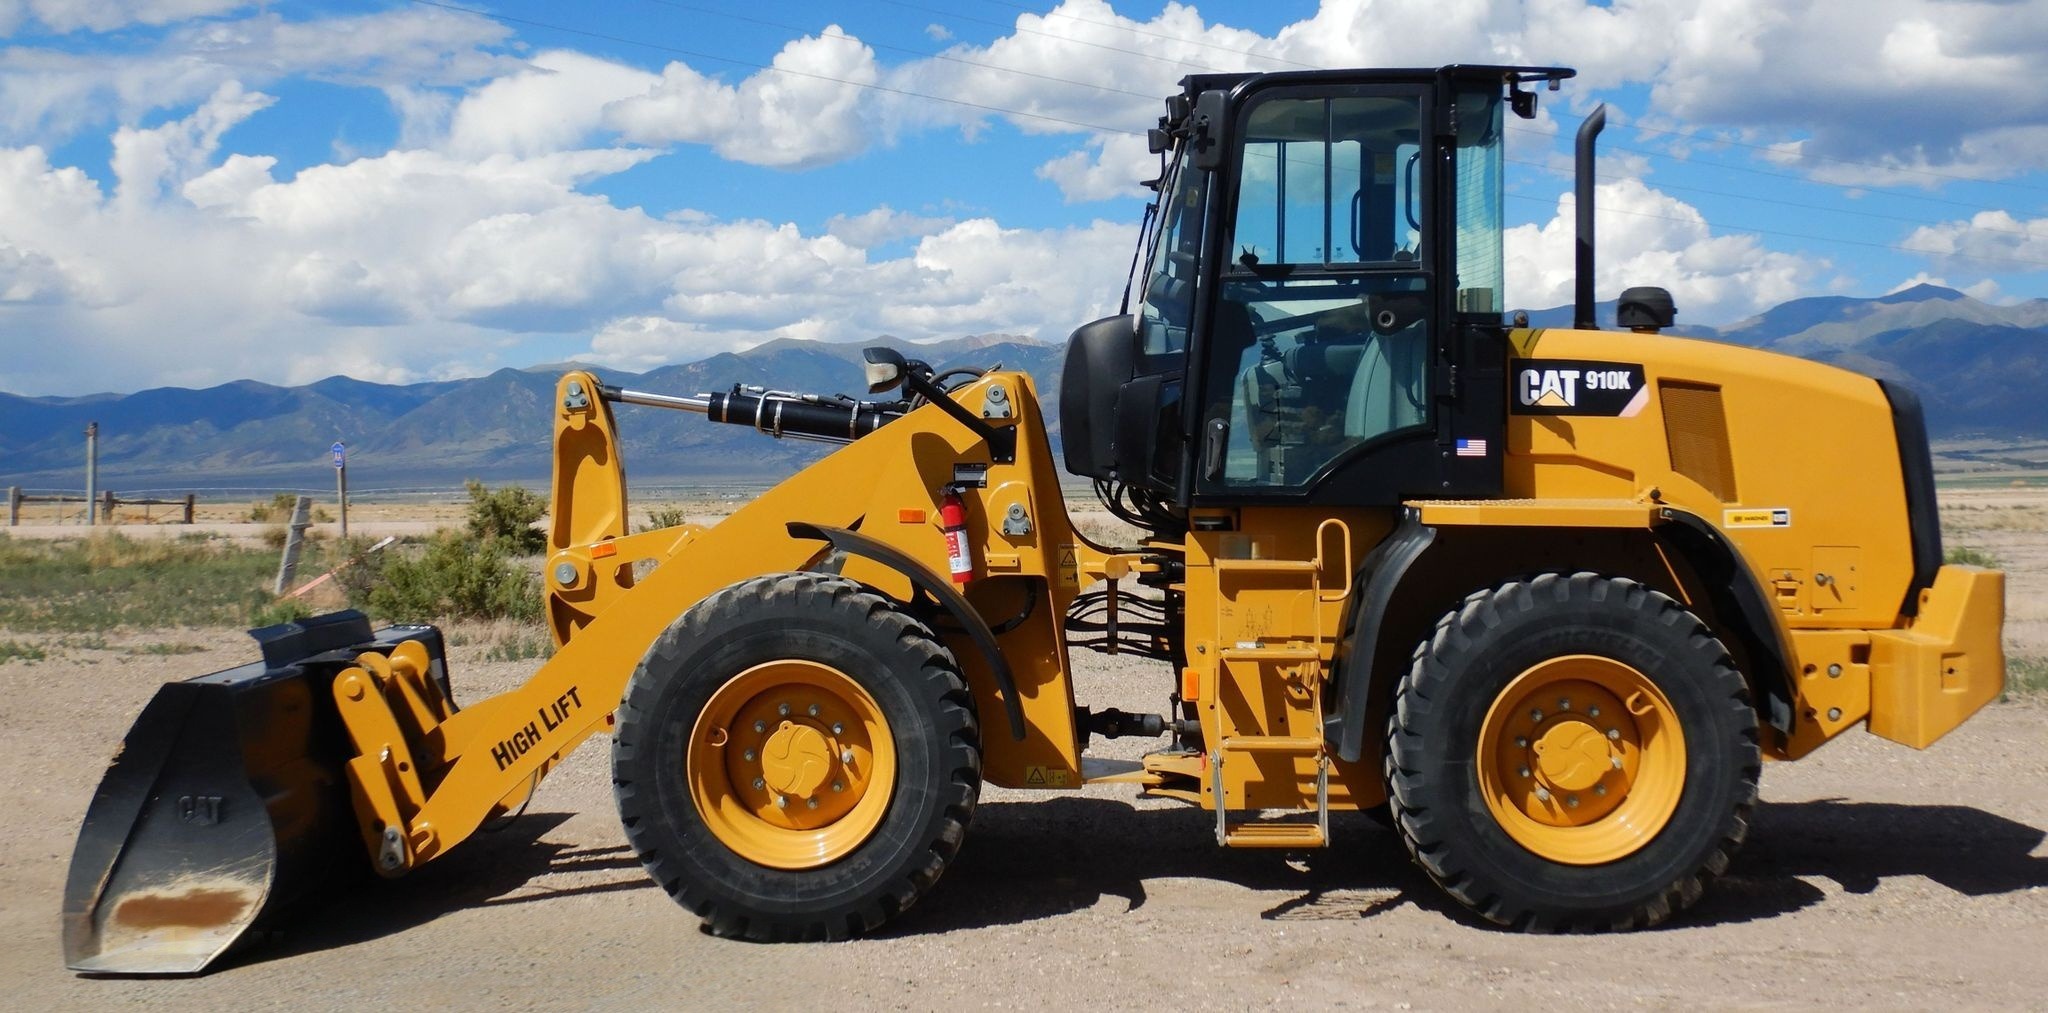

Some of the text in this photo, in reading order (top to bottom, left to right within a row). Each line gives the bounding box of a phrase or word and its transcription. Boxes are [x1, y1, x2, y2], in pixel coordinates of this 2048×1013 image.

[1520, 369, 1631, 406] CAT 910K
[490, 685, 582, 772] HIGH LIFT
[178, 795, 222, 825] CAT
